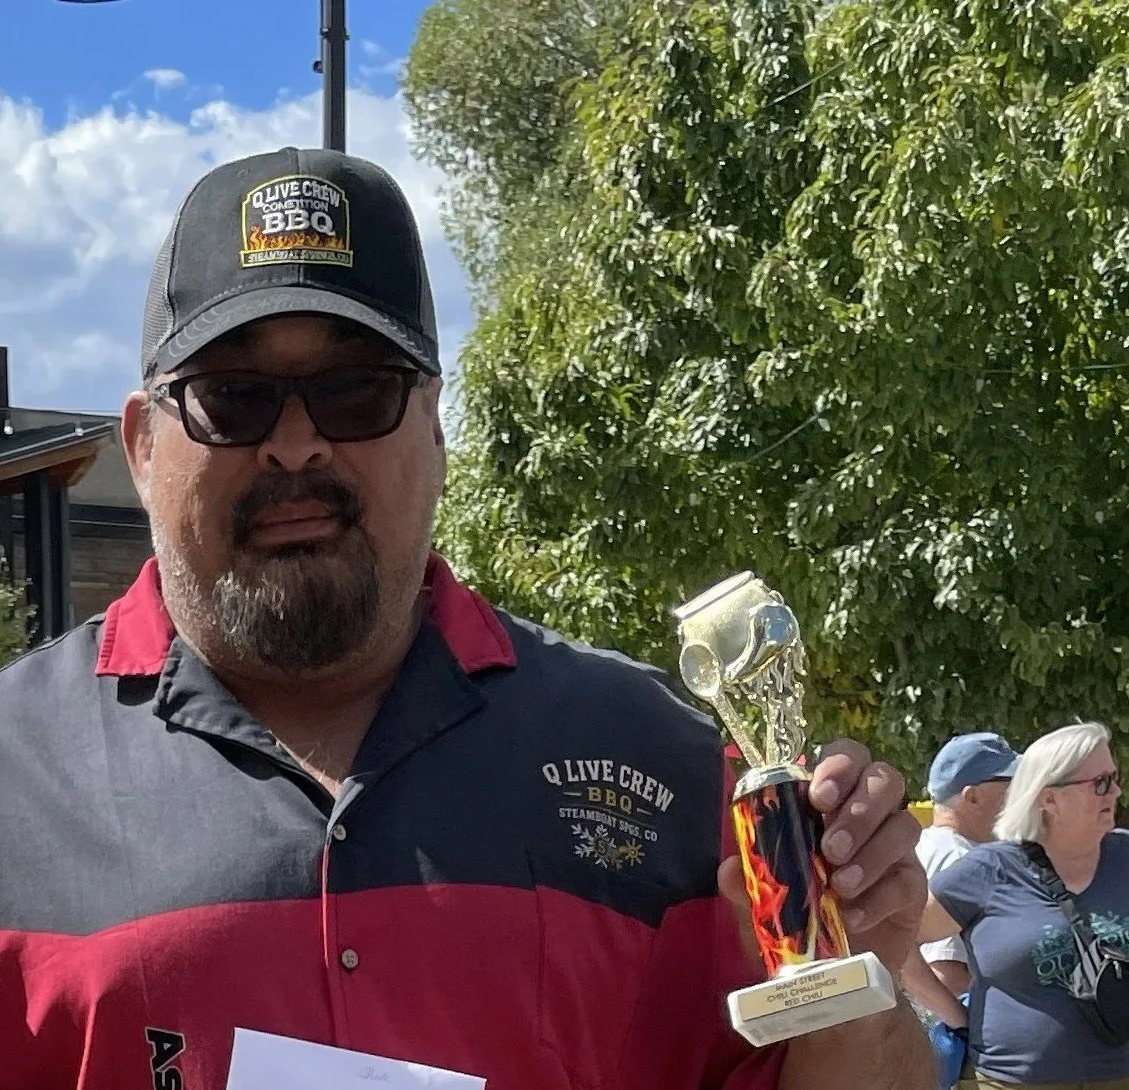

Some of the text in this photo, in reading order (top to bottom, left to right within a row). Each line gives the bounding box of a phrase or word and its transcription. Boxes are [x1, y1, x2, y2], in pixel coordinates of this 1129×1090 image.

[252, 180, 342, 209] Q LIVE CREW
[261, 208, 336, 236] BBQ
[542, 759, 675, 812] Q LIVE CREW
[587, 786, 633, 815] BBQ
[558, 807, 617, 828] STEAMBOAT
[644, 829, 658, 842] CO
